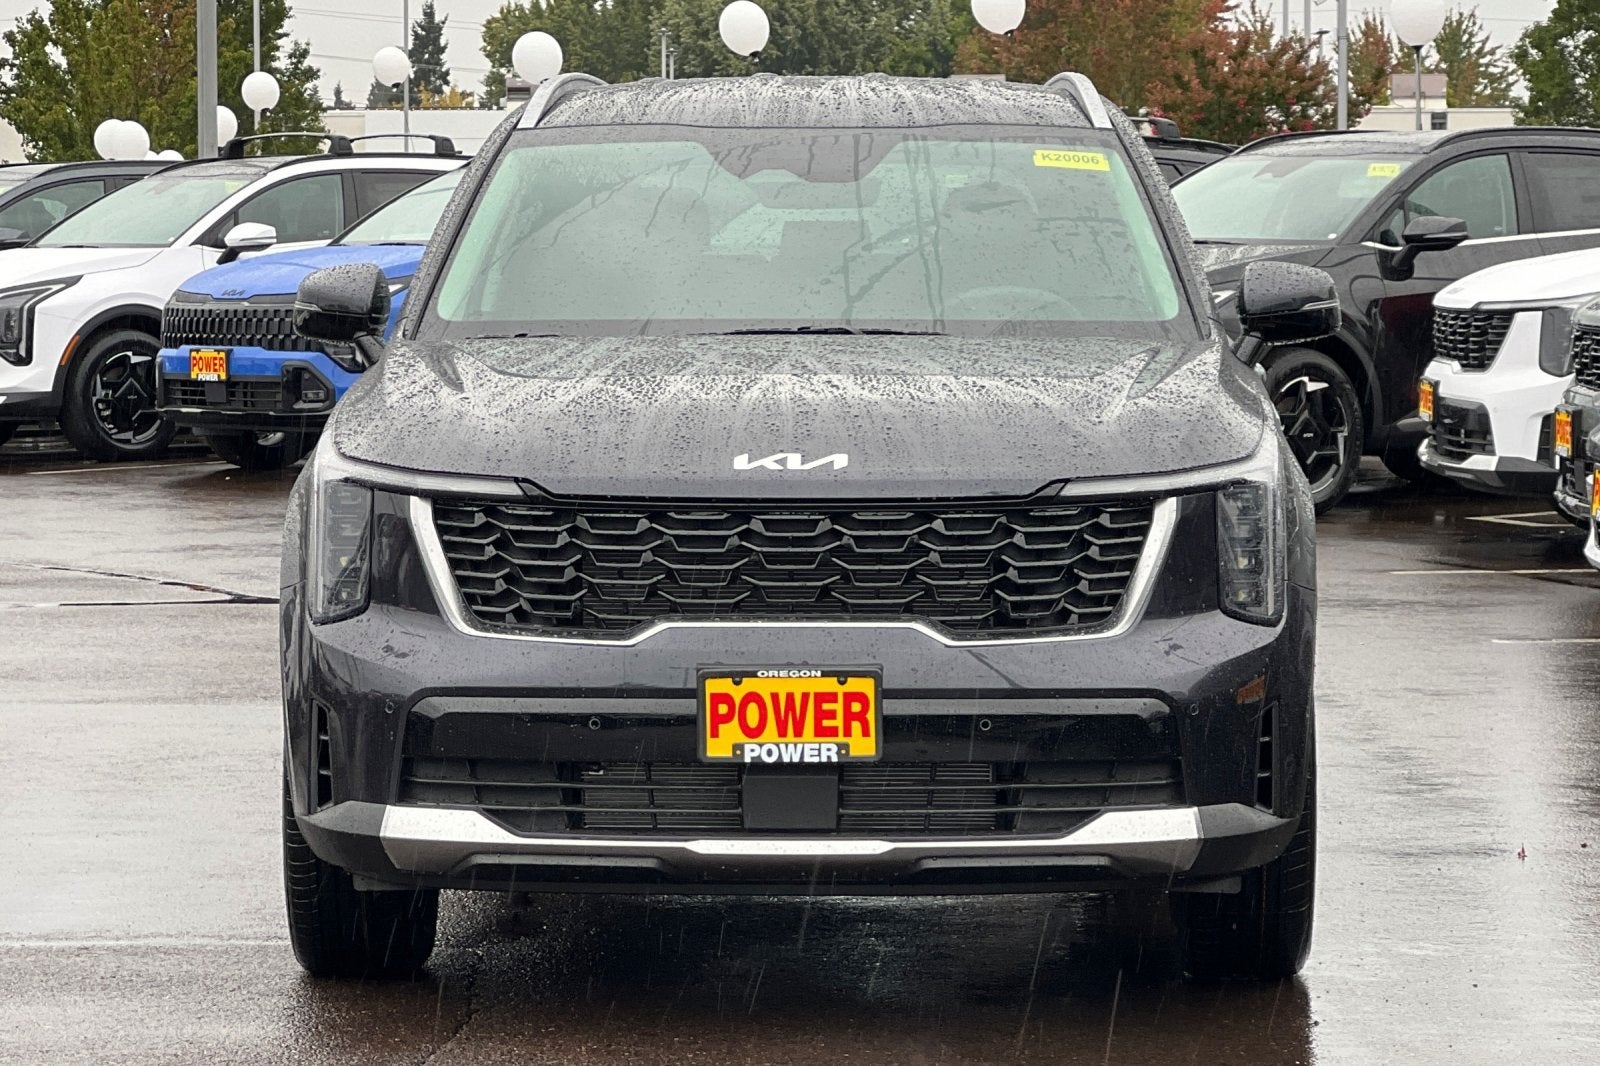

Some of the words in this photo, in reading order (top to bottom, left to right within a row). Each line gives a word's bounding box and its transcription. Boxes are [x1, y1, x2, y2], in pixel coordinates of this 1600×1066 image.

[1041, 153, 1100, 165] K20006
[191, 356, 225, 372] POWER
[757, 670, 822, 678] OREGON
[709, 691, 871, 739] POWER
[743, 743, 839, 763] POWER
